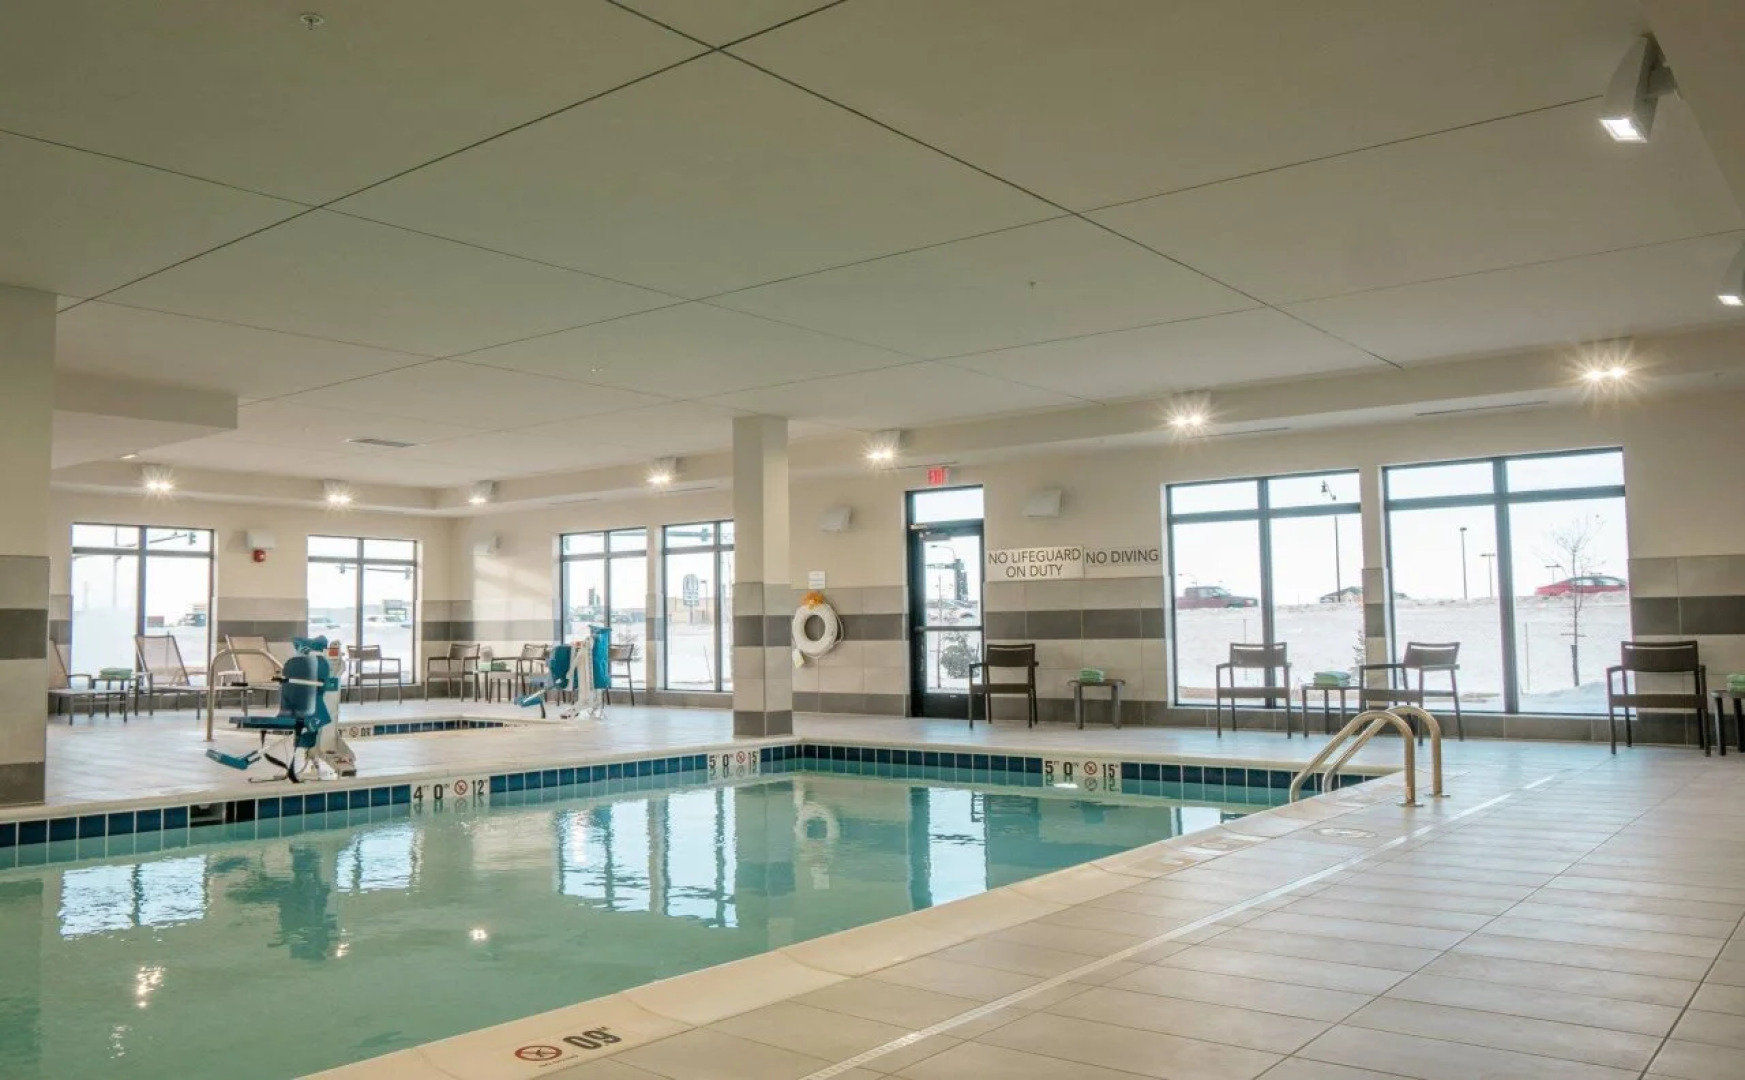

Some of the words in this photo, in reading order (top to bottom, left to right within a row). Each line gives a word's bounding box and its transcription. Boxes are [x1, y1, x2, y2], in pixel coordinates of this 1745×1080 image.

[988, 551, 1009, 564] NO
[1011, 547, 1082, 564] LIFEGUARD
[1086, 550, 1108, 564] NO
[1110, 549, 1159, 563] DIVING
[1006, 565, 1026, 578] ON
[1029, 564, 1063, 577] DUTY
[1045, 760, 1055, 775] 5
[1063, 761, 1073, 776] 0
[413, 784, 424, 802] 4
[433, 783, 444, 800] 0
